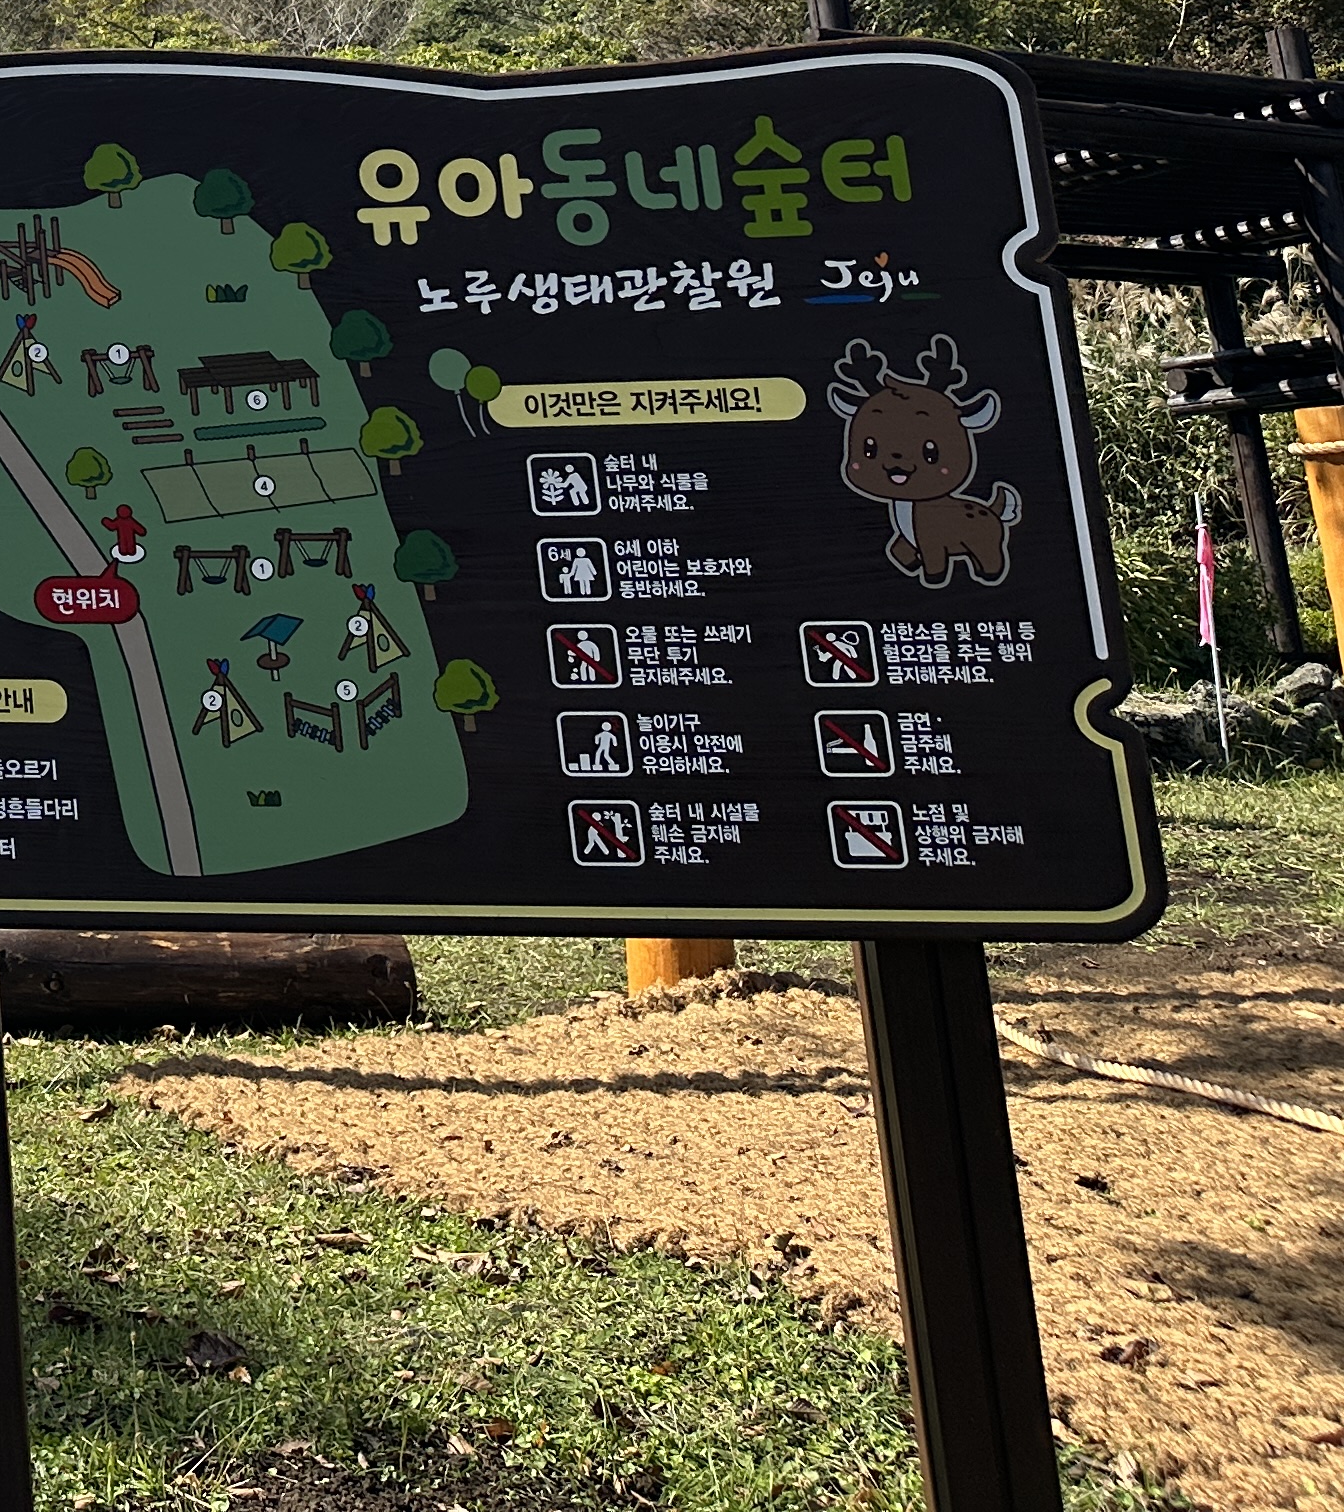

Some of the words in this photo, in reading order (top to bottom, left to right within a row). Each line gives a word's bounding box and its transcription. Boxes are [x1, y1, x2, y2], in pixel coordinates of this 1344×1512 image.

[820, 252, 919, 302] Jeju
[418, 259, 781, 314] 노루생태관찰원
[525, 391, 621, 418] 이것만은
[630, 387, 762, 415] 지켜주세요!
[604, 454, 635, 471] 숲터
[642, 454, 657, 470] 내
[606, 474, 654, 492] 나무와
[660, 473, 708, 490] 식물을
[609, 493, 694, 512] 아껴주세요.
[548, 547, 572, 561] 6세
[615, 539, 641, 557] 6세
[647, 539, 679, 556] 이하
[617, 560, 679, 577] 어린이는
[687, 558, 752, 576] 보호자와
[619, 580, 705, 598] 동반하세요.
[52, 589, 119, 614] 현위치
[626, 626, 657, 643] 오물
[665, 626, 697, 643] 또는
[704, 625, 751, 643] 쓰레기
[881, 623, 948, 641] 심한소음
[954, 623, 971, 640] 및
[978, 622, 1011, 640] 악취
[1018, 622, 1035, 640] 등
[628, 647, 660, 664] 무단
[667, 646, 698, 664] 투기
[883, 643, 950, 662] 혐오감을
[958, 644, 991, 662] 주는
[998, 643, 1032, 662] 행위
[630, 667, 732, 685] 금지해주세요.
[887, 666, 994, 684] 금지해주세요.
[637, 714, 701, 732] 놀이기구
[640, 735, 687, 753] 이용시
[694, 735, 743, 753] 안전에
[901, 734, 952, 753] 금주해
[643, 756, 729, 774] 유의하세요.
[904, 756, 961, 774] 주세요.
[649, 803, 681, 821] 숲터
[688, 803, 704, 821] 내
[711, 803, 759, 821] 시설물
[913, 804, 945, 822] 노점
[952, 804, 969, 822] 및
[651, 824, 684, 842] 훼손
[691, 825, 740, 843] 금지해
[915, 825, 966, 844] 상행위
[972, 826, 1024, 844] 금지해
[655, 846, 709, 864] 주세요.
[919, 848, 975, 866] 주세요.
